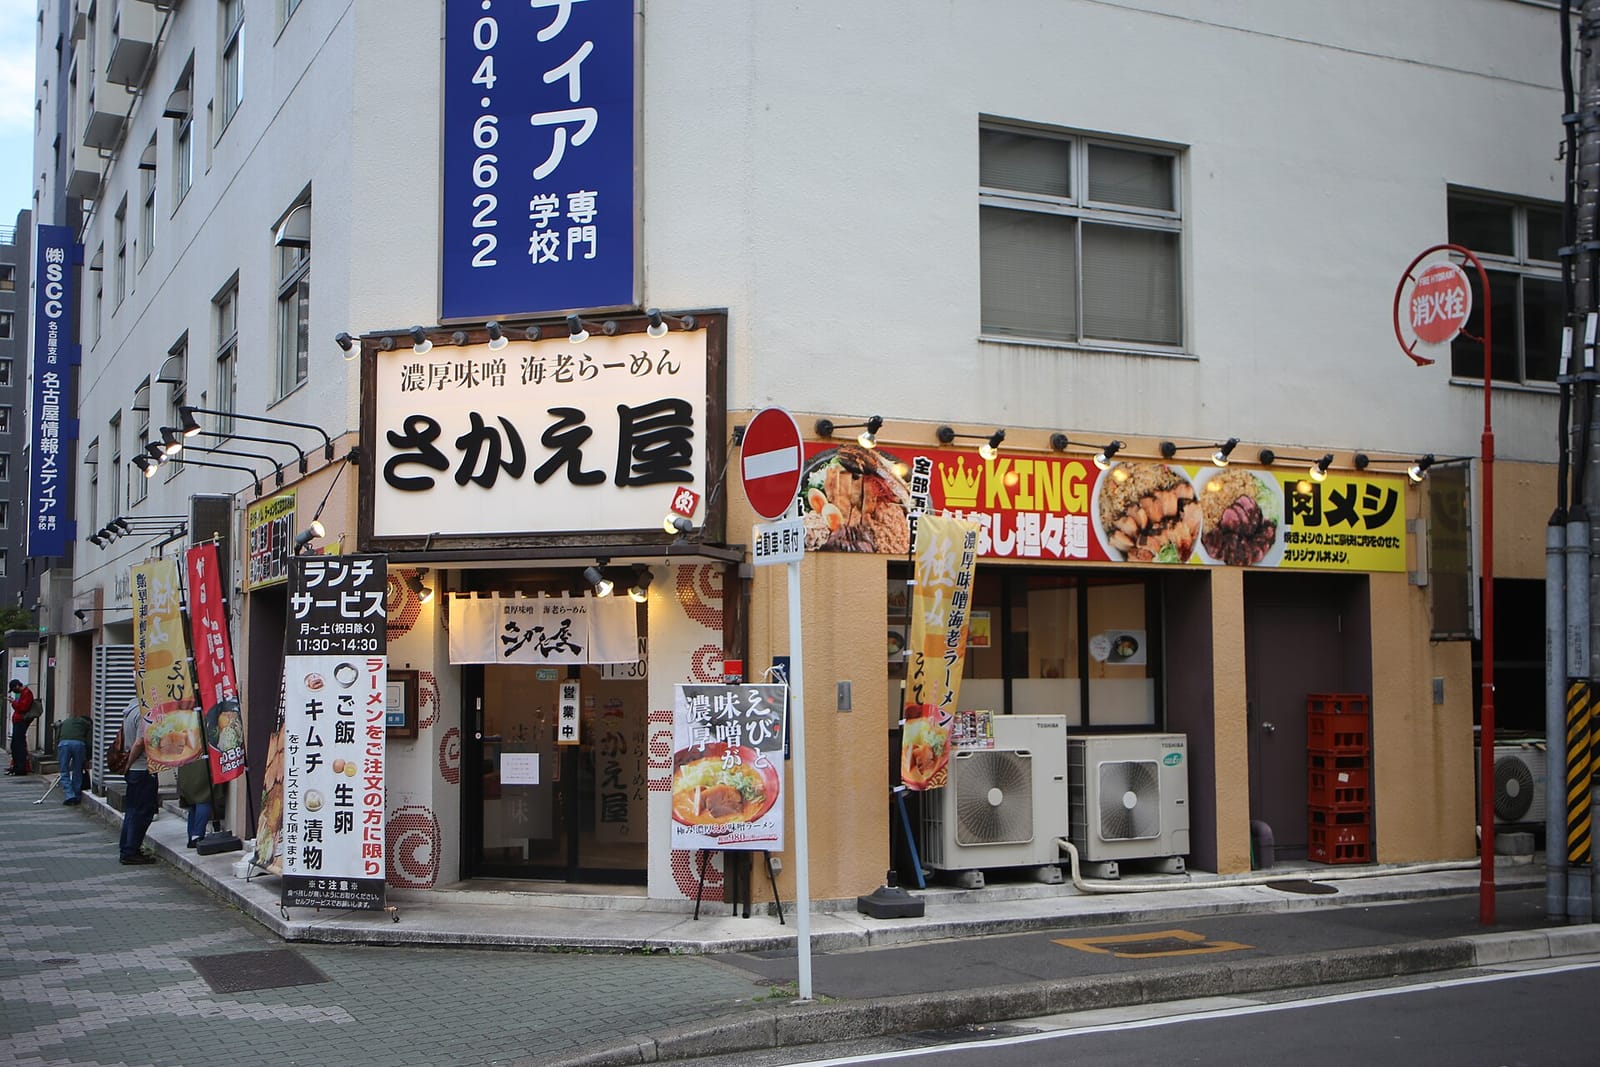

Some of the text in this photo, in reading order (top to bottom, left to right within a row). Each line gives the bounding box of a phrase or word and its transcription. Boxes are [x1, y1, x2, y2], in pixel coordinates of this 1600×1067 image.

[528, 193, 560, 264] 学校
[566, 190, 598, 260] 専門
[1412, 286, 1465, 327] 消火栓
[400, 348, 681, 392] 濃厚味噌 海老らーめん
[39, 372, 60, 513] 名古屋情報メディア
[383, 397, 694, 492] さかえ屋
[985, 456, 1089, 514] KING
[1283, 480, 1399, 531] 肉メシ
[941, 508, 1089, 560] なし担々麺
[304, 559, 374, 588] ランチ
[290, 591, 387, 620] サービス
[938, 530, 977, 728] 濃厚味噌海老ラーメン
[601, 659, 647, 678] 11:30
[304, 699, 324, 775] キムチ
[335, 695, 356, 745] ご飯
[562, 685, 576, 738] 営業中
[685, 694, 712, 752] 濃厚
[714, 691, 742, 770] 味噌が
[745, 689, 773, 770] えびと
[361, 658, 384, 877] ラーメンをご注文の方に限り
[286, 733, 300, 873] をサービスさせて頂きます。
[333, 783, 355, 835] 生卵
[302, 818, 324, 871] 漬物
